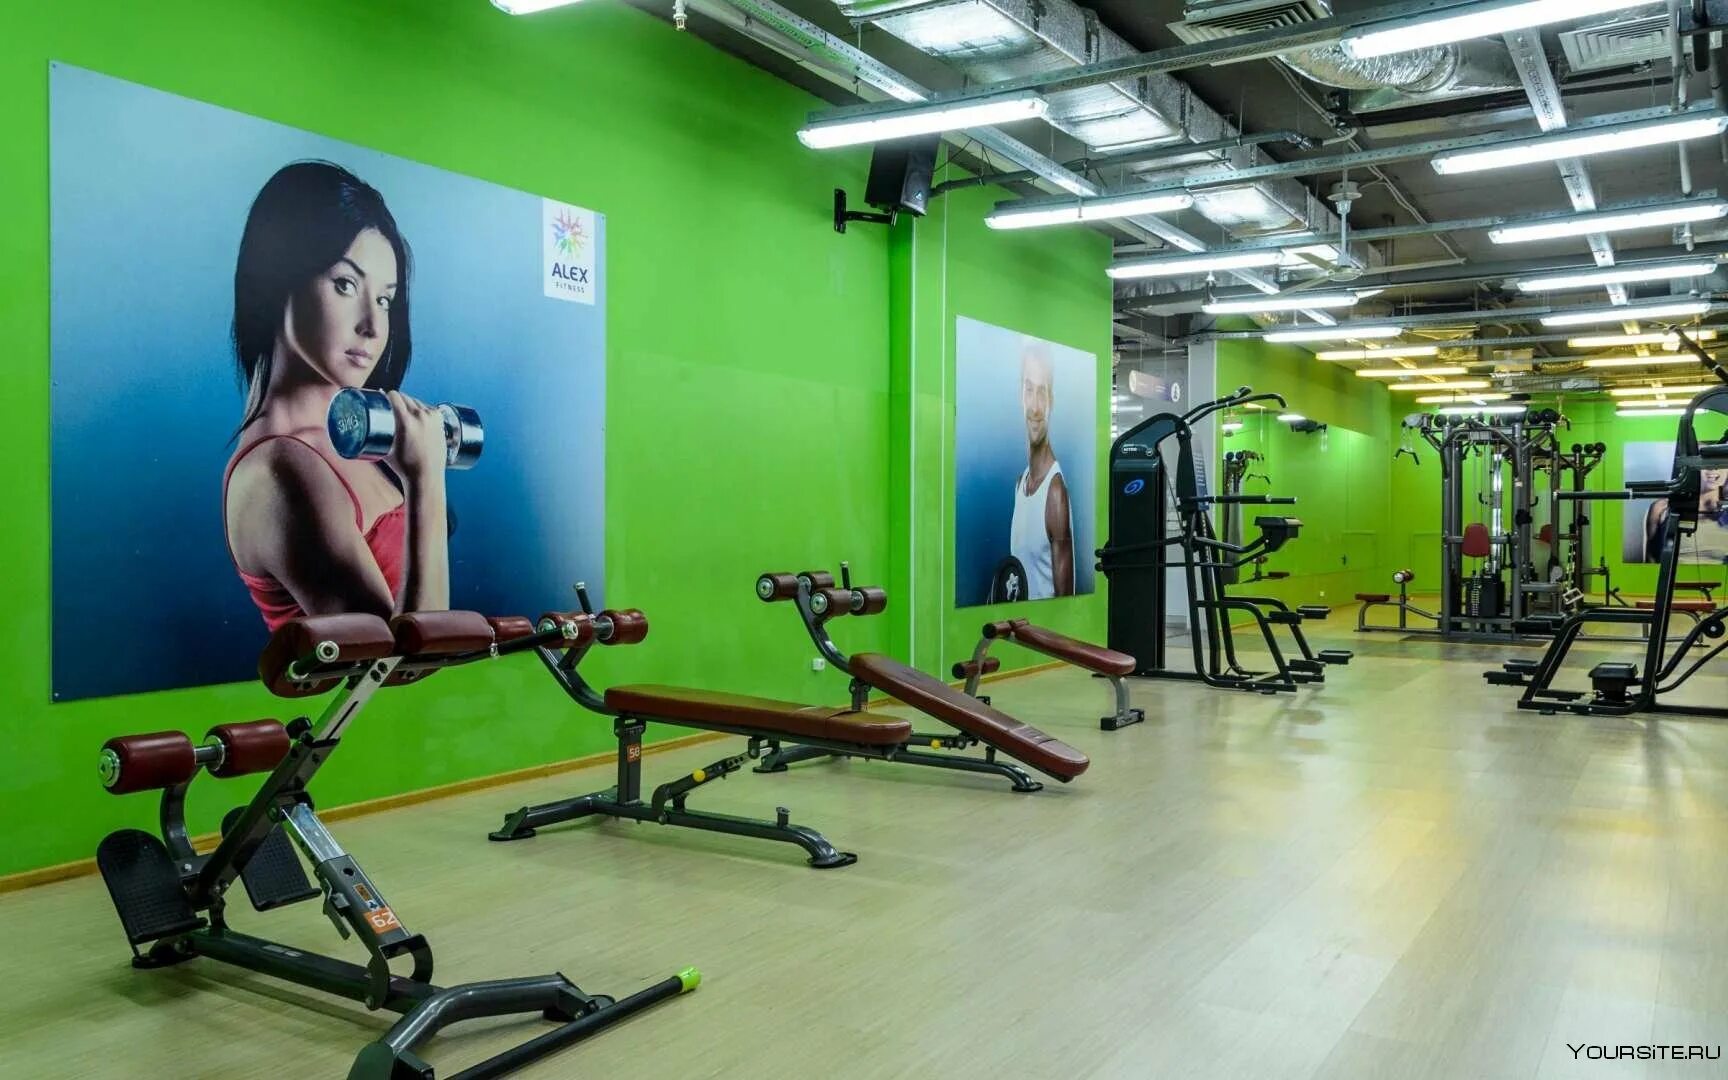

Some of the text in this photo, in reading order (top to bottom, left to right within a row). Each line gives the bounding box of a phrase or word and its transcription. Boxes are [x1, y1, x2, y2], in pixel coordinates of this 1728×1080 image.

[552, 262, 588, 284] ALEX
[555, 281, 585, 294] FITNESS
[371, 911, 397, 928] 62
